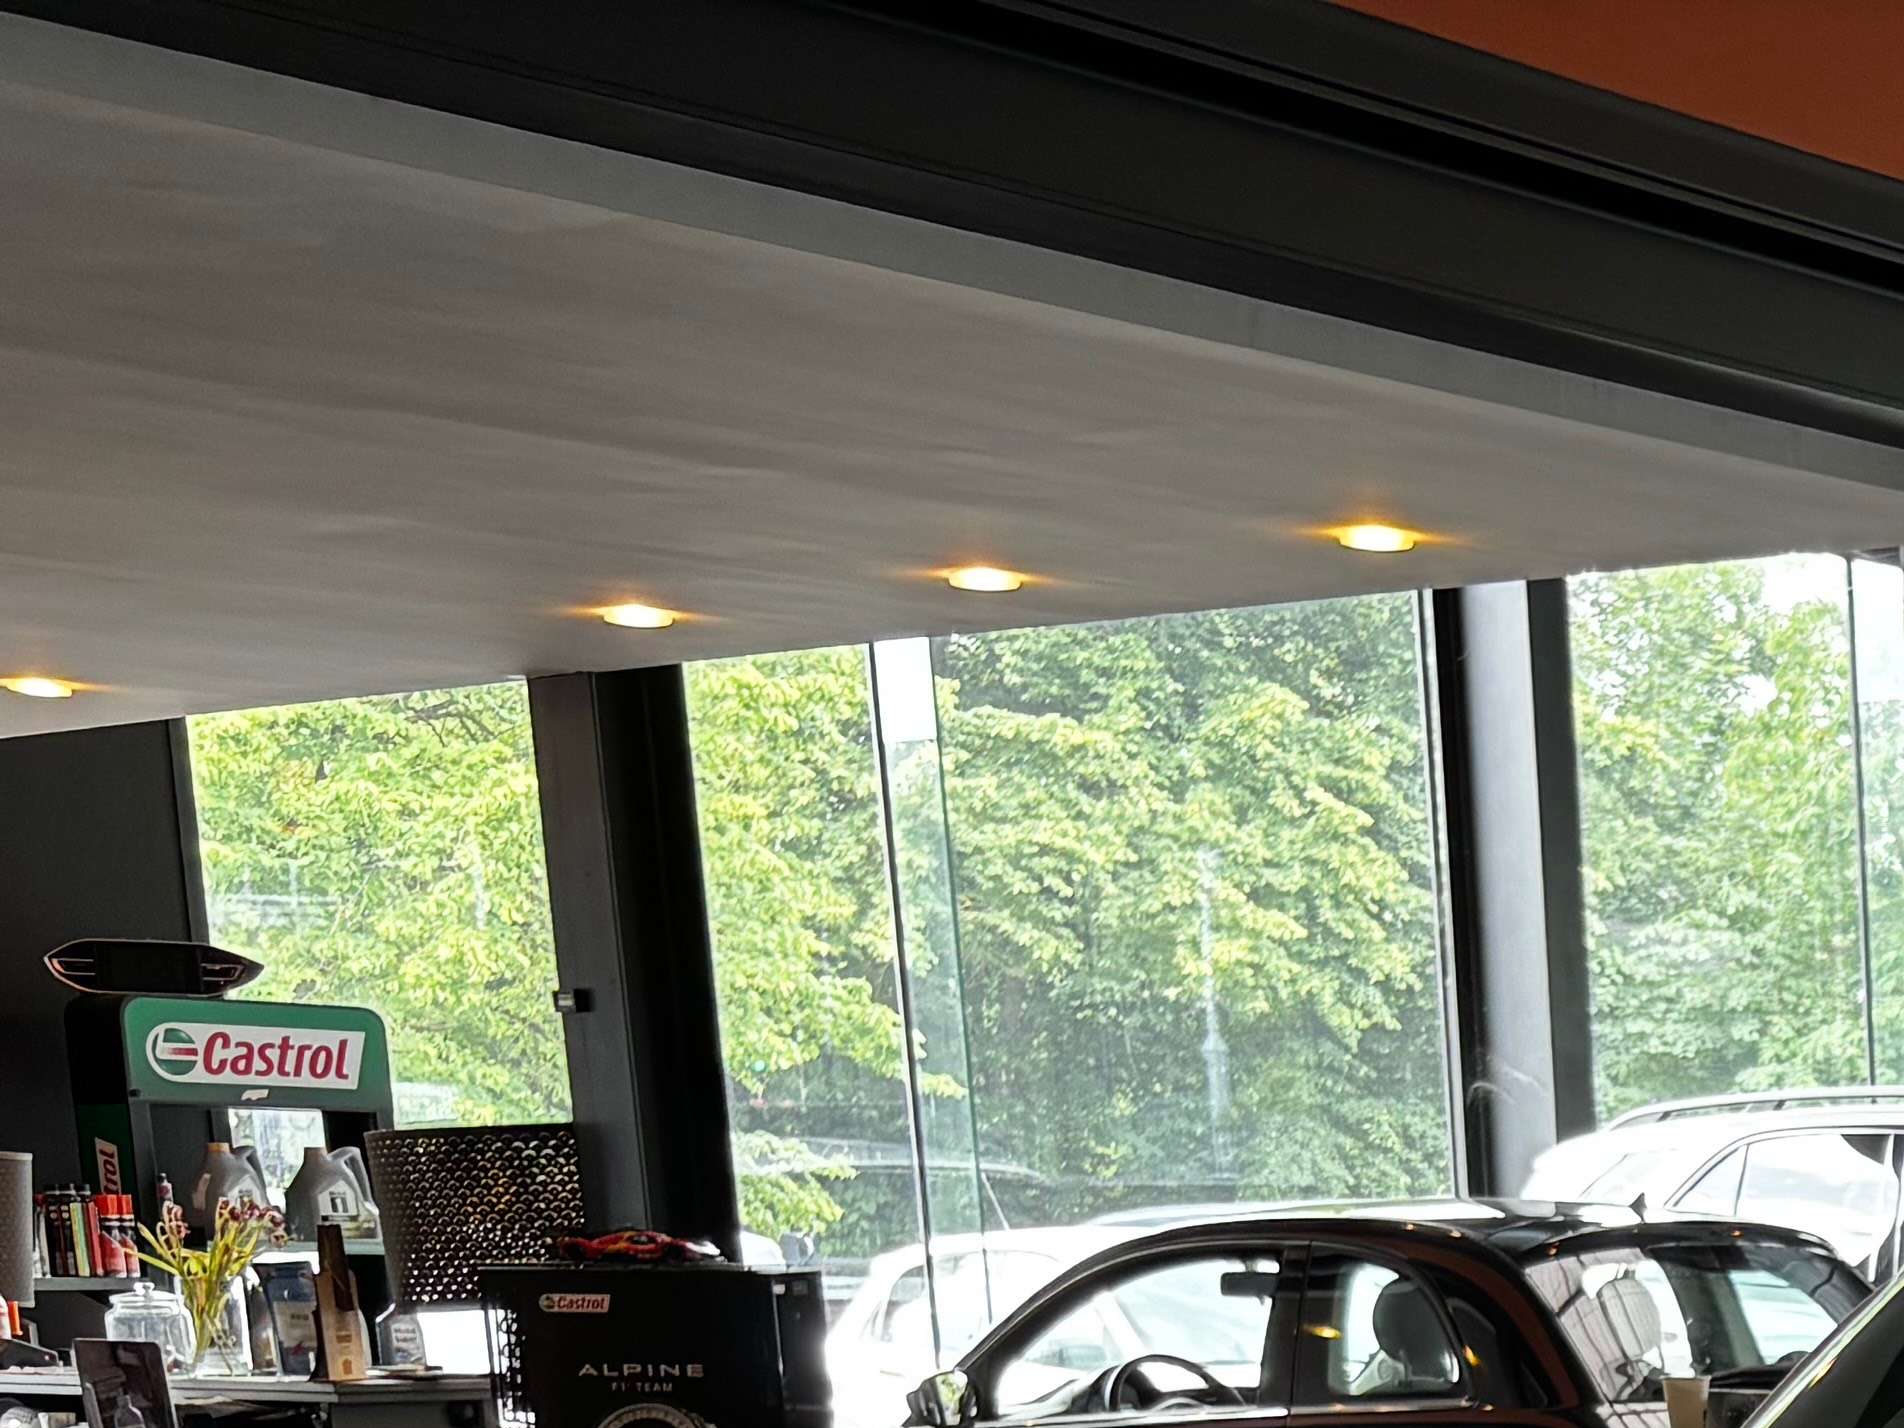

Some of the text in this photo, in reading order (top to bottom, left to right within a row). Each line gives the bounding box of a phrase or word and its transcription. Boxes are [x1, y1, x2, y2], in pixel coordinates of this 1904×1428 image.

[203, 1031, 350, 1080] Castrol
[557, 1295, 606, 1311] Castrol
[578, 1363, 705, 1378] ALPINE
[636, 1382, 673, 1392] TEAM
